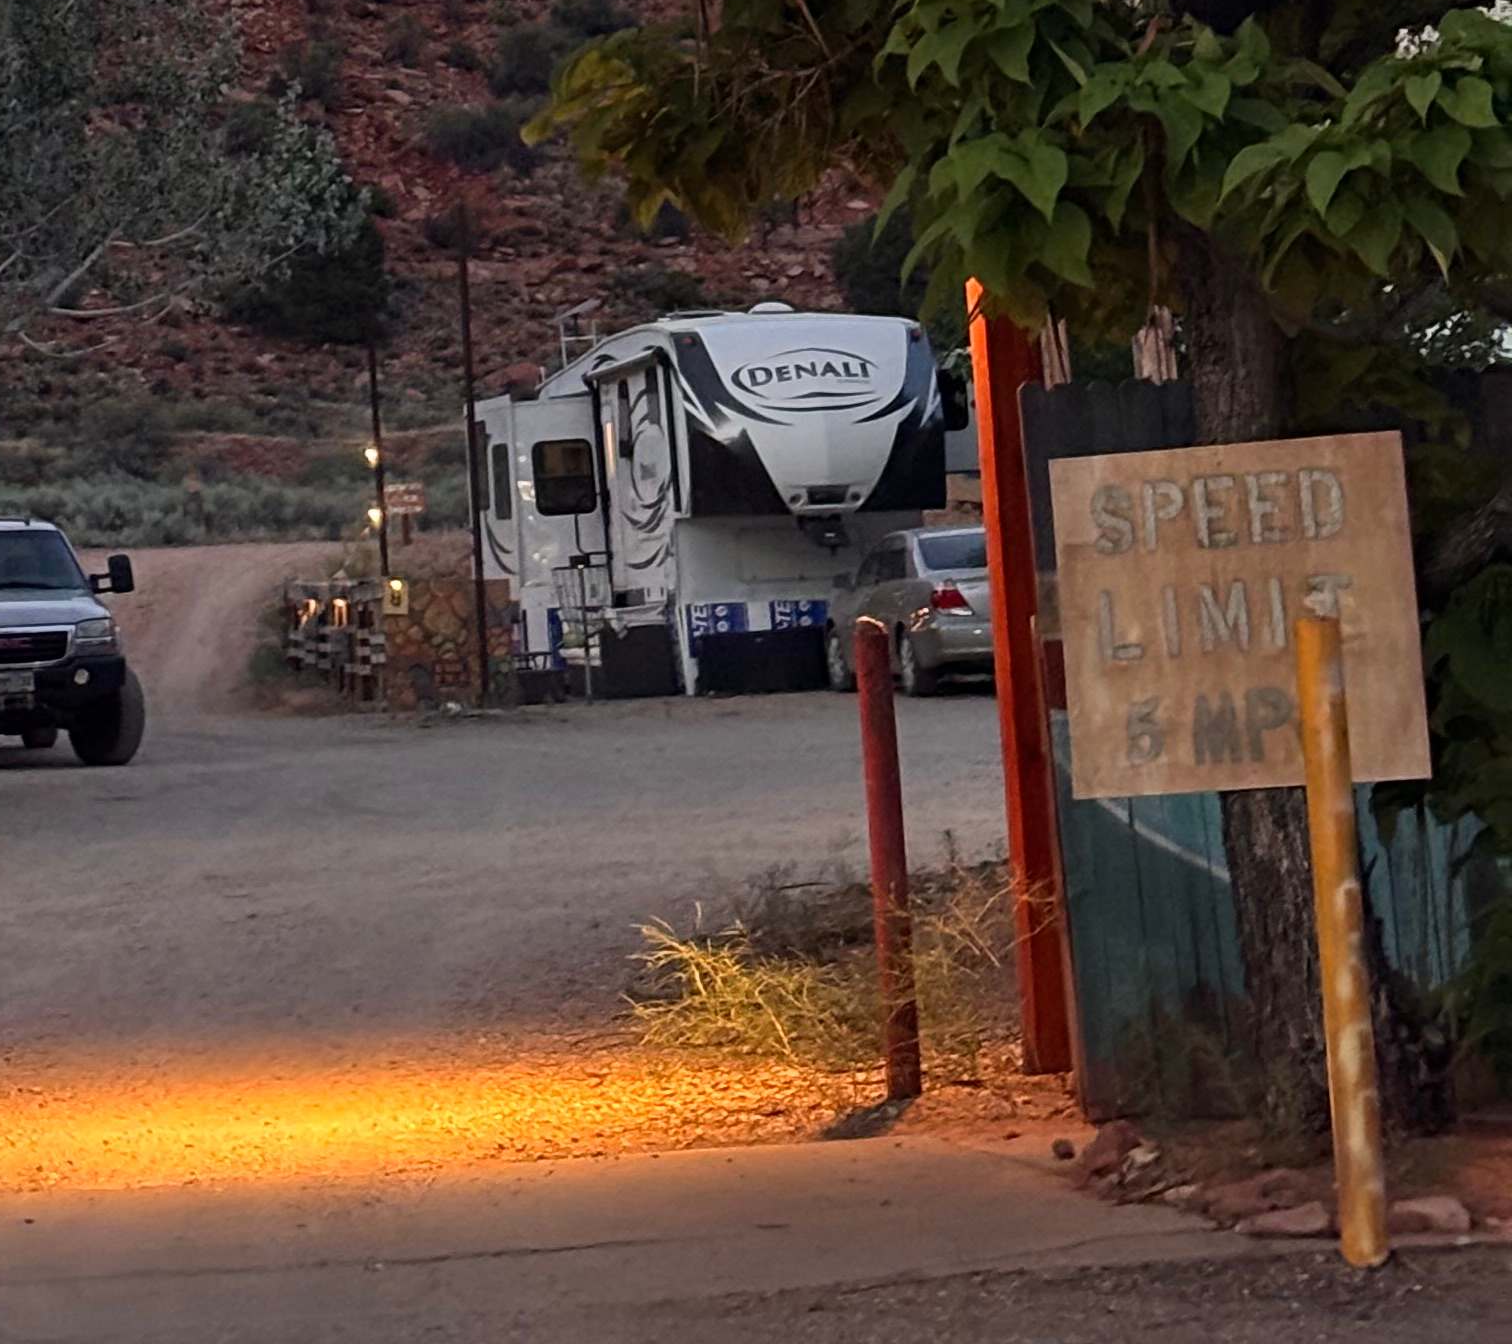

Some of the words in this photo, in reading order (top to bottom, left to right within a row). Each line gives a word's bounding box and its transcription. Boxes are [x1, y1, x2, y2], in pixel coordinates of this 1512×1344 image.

[747, 362, 870, 387] DENALI
[1091, 468, 1344, 555] SPEED
[1126, 696, 1166, 762] 5
